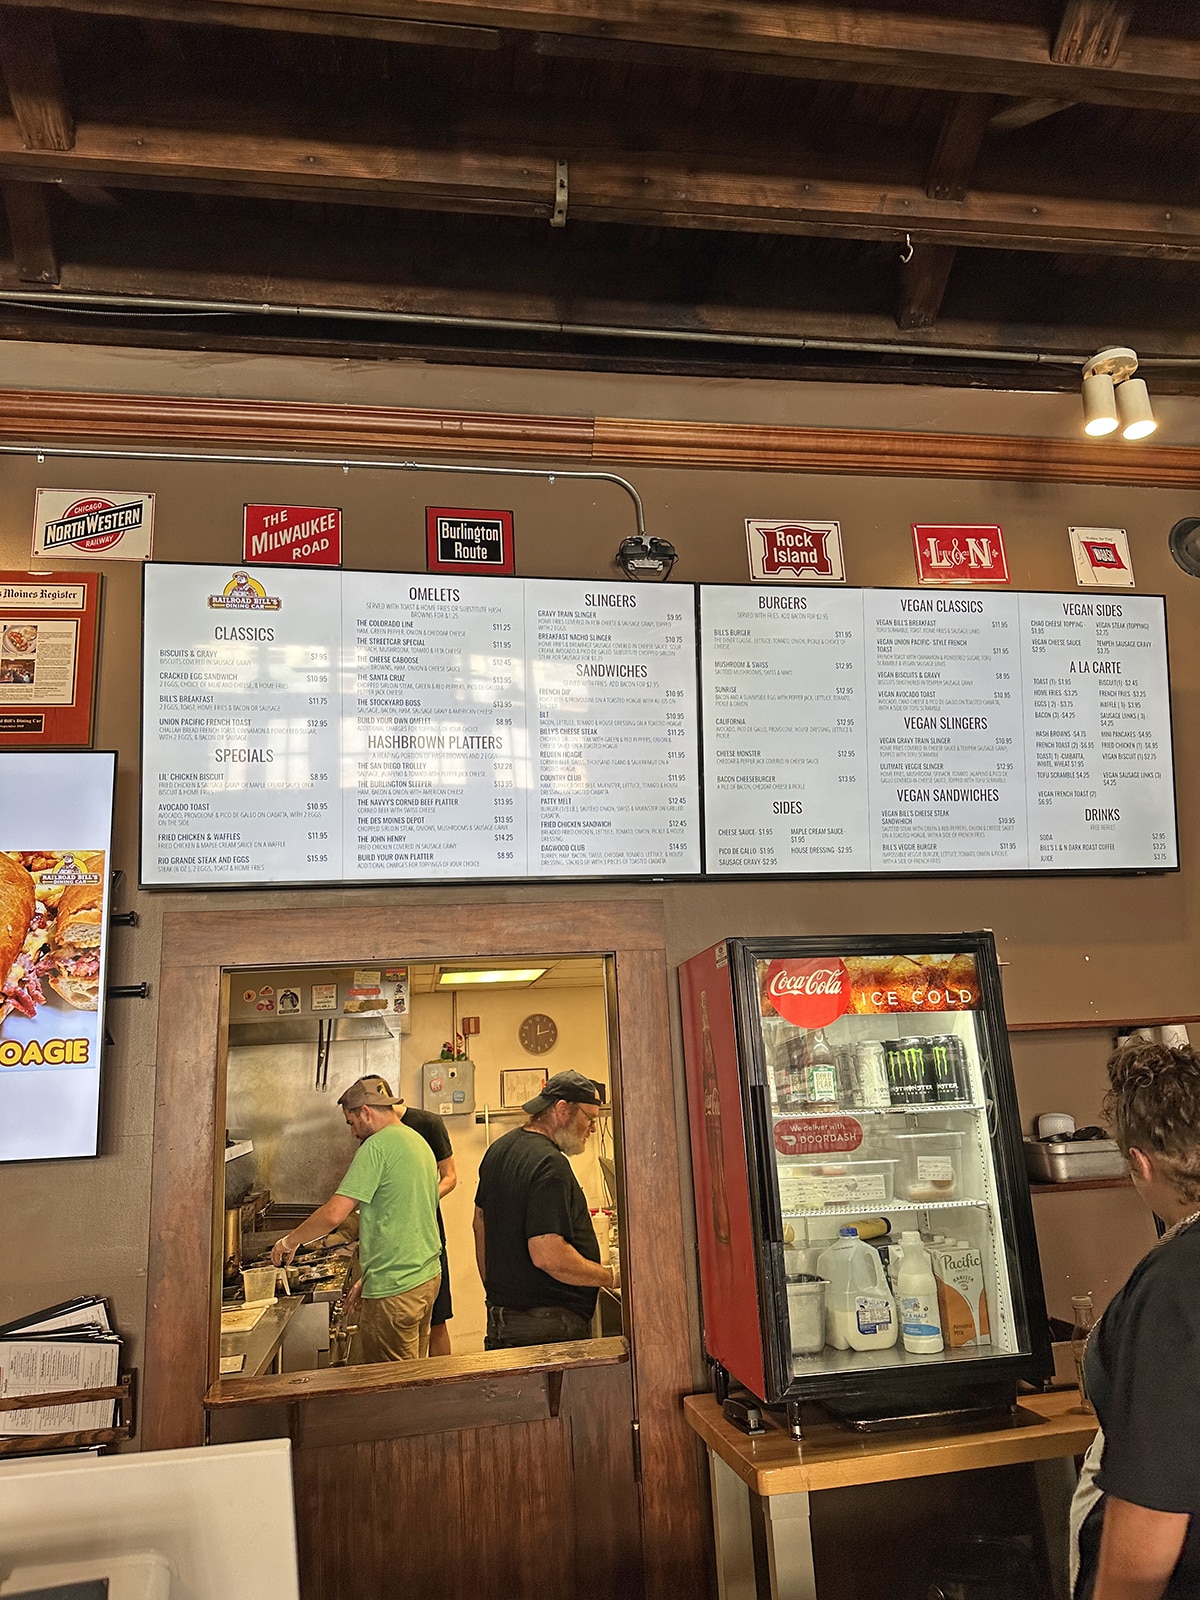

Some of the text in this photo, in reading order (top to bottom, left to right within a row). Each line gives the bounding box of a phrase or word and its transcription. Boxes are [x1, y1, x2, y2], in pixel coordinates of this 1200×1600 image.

[74, 502, 102, 514] CHICAGO
[263, 510, 287, 528] THE
[252, 513, 335, 557] MILWAUKEE
[442, 522, 498, 543] Burlington
[776, 532, 813, 547] Rock
[85, 535, 114, 547] RAILWAY
[293, 538, 329, 560] ROAD
[455, 541, 487, 559] Route
[774, 547, 817, 563] Island
[3, 589, 77, 600] Moines Register
[254, 597, 278, 605] BILL'S
[409, 587, 460, 601] OMELETS
[585, 594, 636, 607] SLINGERS
[759, 596, 807, 609] BURGERS
[901, 599, 983, 613] VEGAN CLASSICS
[1063, 603, 1123, 617] VEGAN SIDES
[215, 627, 275, 641] CLASSICS
[576, 664, 648, 678] SANDWICHES
[1070, 661, 1121, 674] A LA CARTE
[204, 673, 238, 681] SANDWICH
[160, 695, 177, 703] BILL'S
[904, 717, 988, 729] VEGAN SLINGERS
[368, 735, 503, 749] HASHBROWN PLATTERS
[215, 749, 274, 763] SPECIALS
[897, 789, 999, 801] VEGAN SANDWICHES
[773, 801, 803, 814] SIDES
[1085, 808, 1120, 821] DRINKS
[177, 833, 205, 841] CHICKEN
[770, 968, 845, 996] Coca-Cola
[863, 990, 972, 1005] ICE COLD
[817, 1081, 832, 1089] PEAK
[800, 1133, 857, 1144] DOORDASH
[941, 1253, 981, 1270] Pacific
